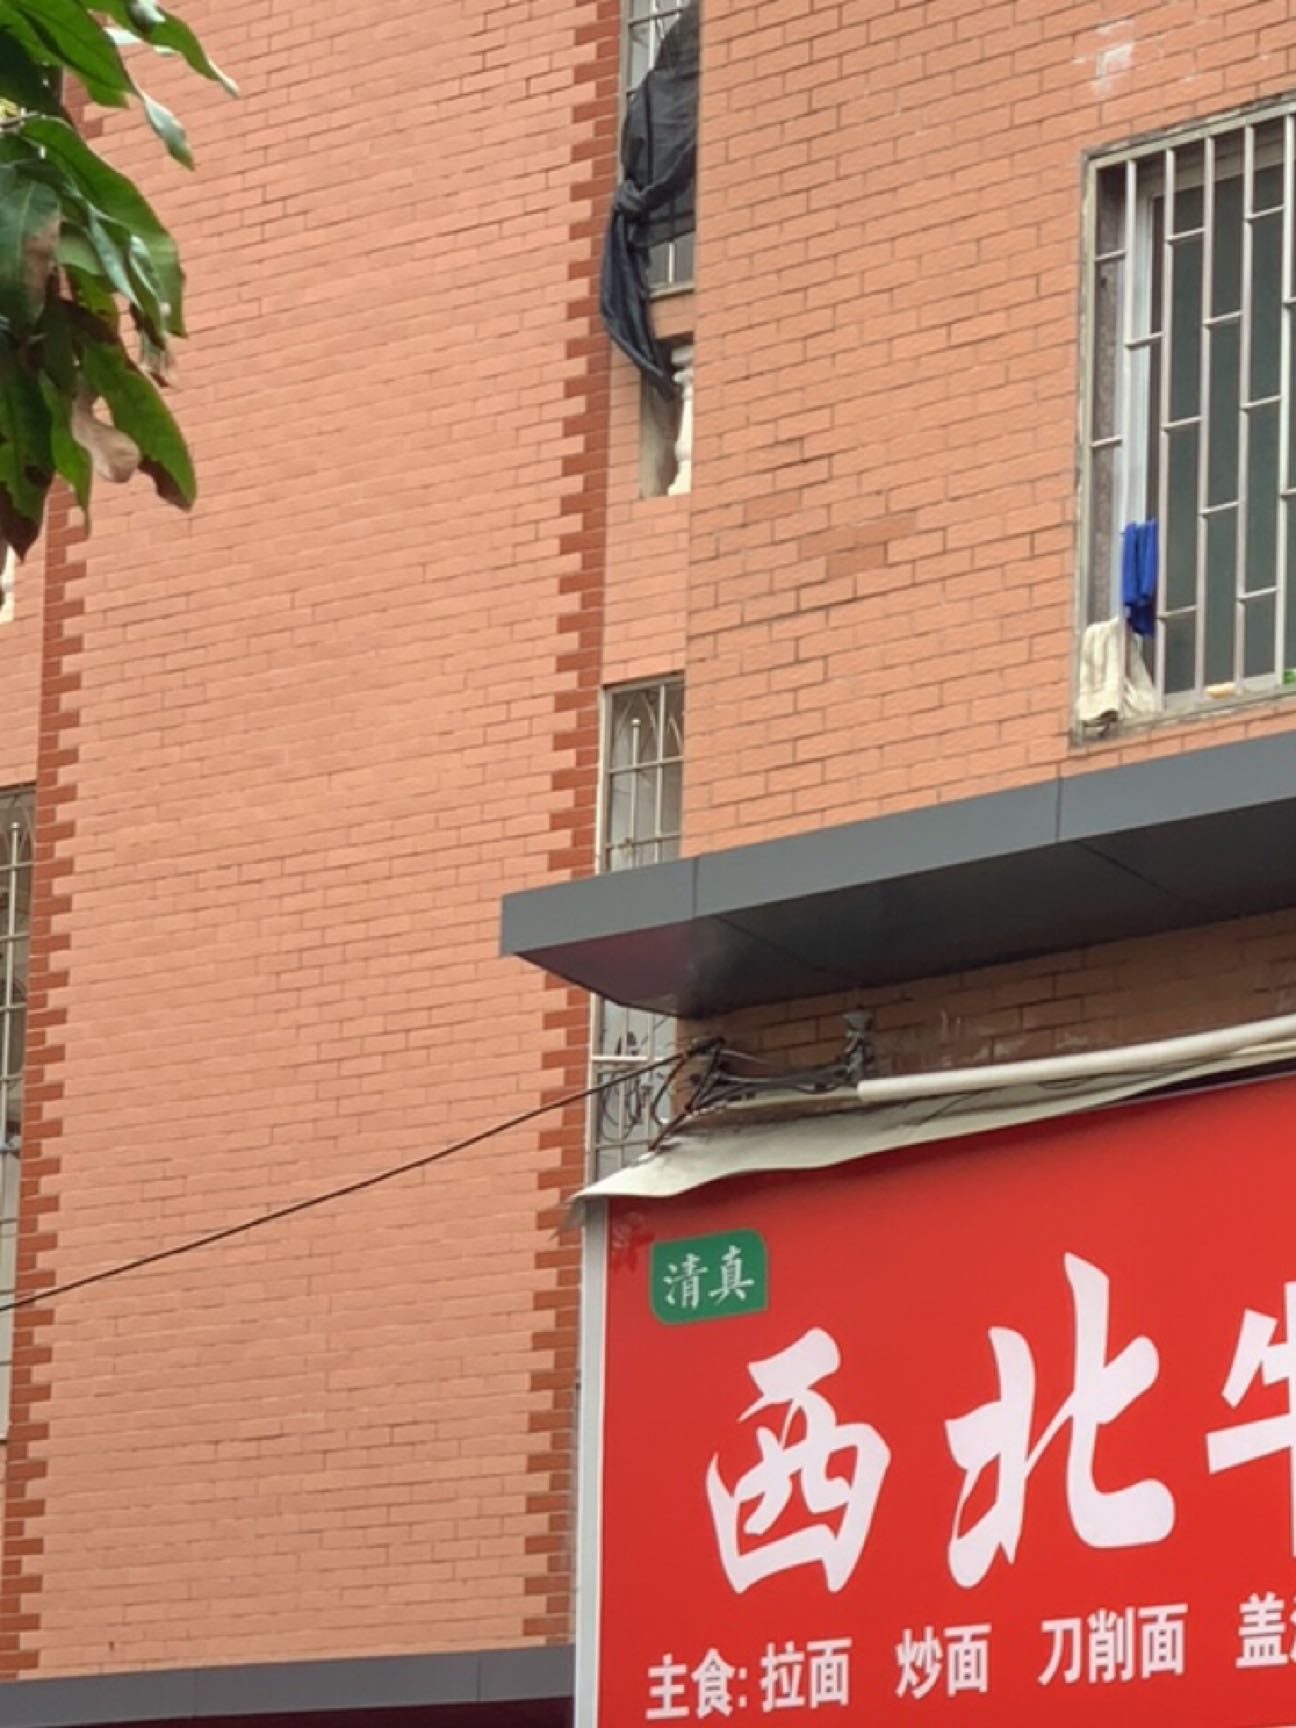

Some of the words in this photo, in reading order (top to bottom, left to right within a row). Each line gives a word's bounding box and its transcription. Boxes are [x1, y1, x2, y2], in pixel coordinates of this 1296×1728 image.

[662, 1244, 755, 1311] 清真
[895, 1622, 993, 1700] 炒面
[1037, 1602, 1189, 1687] 刀削面
